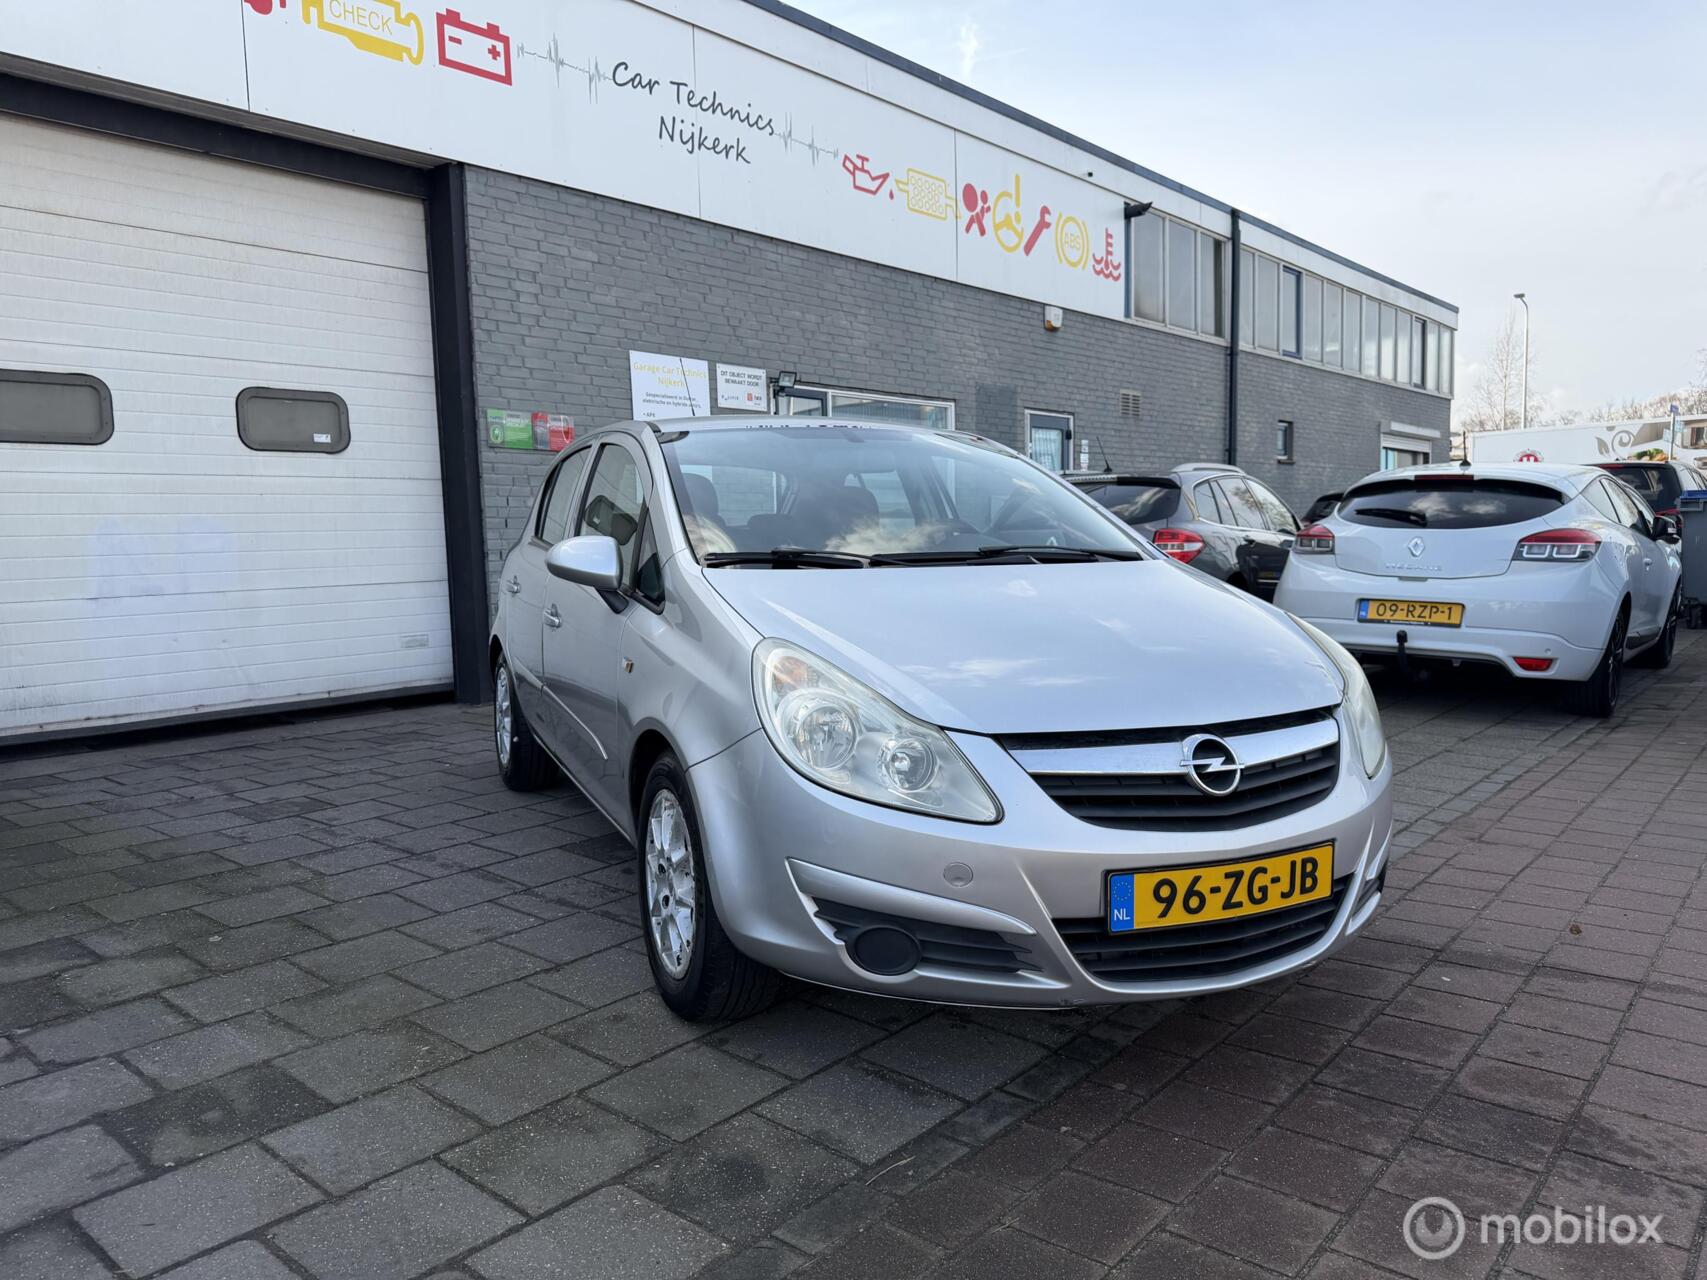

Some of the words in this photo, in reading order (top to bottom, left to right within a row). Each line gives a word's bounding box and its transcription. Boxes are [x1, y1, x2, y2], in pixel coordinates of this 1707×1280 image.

[329, 0, 393, 35] CHECK
[612, 61, 660, 95] Car
[669, 80, 775, 136] Technics
[658, 115, 751, 164] Nijkerk
[1063, 231, 1082, 251] ABS
[633, 361, 661, 374] Garage
[662, 365, 674, 376] Car
[729, 371, 746, 379] OBJECT
[1376, 603, 1453, 620] 09-RZP-1
[1153, 856, 1318, 918] 96-ZG-JB
[1113, 908, 1131, 921] NL
